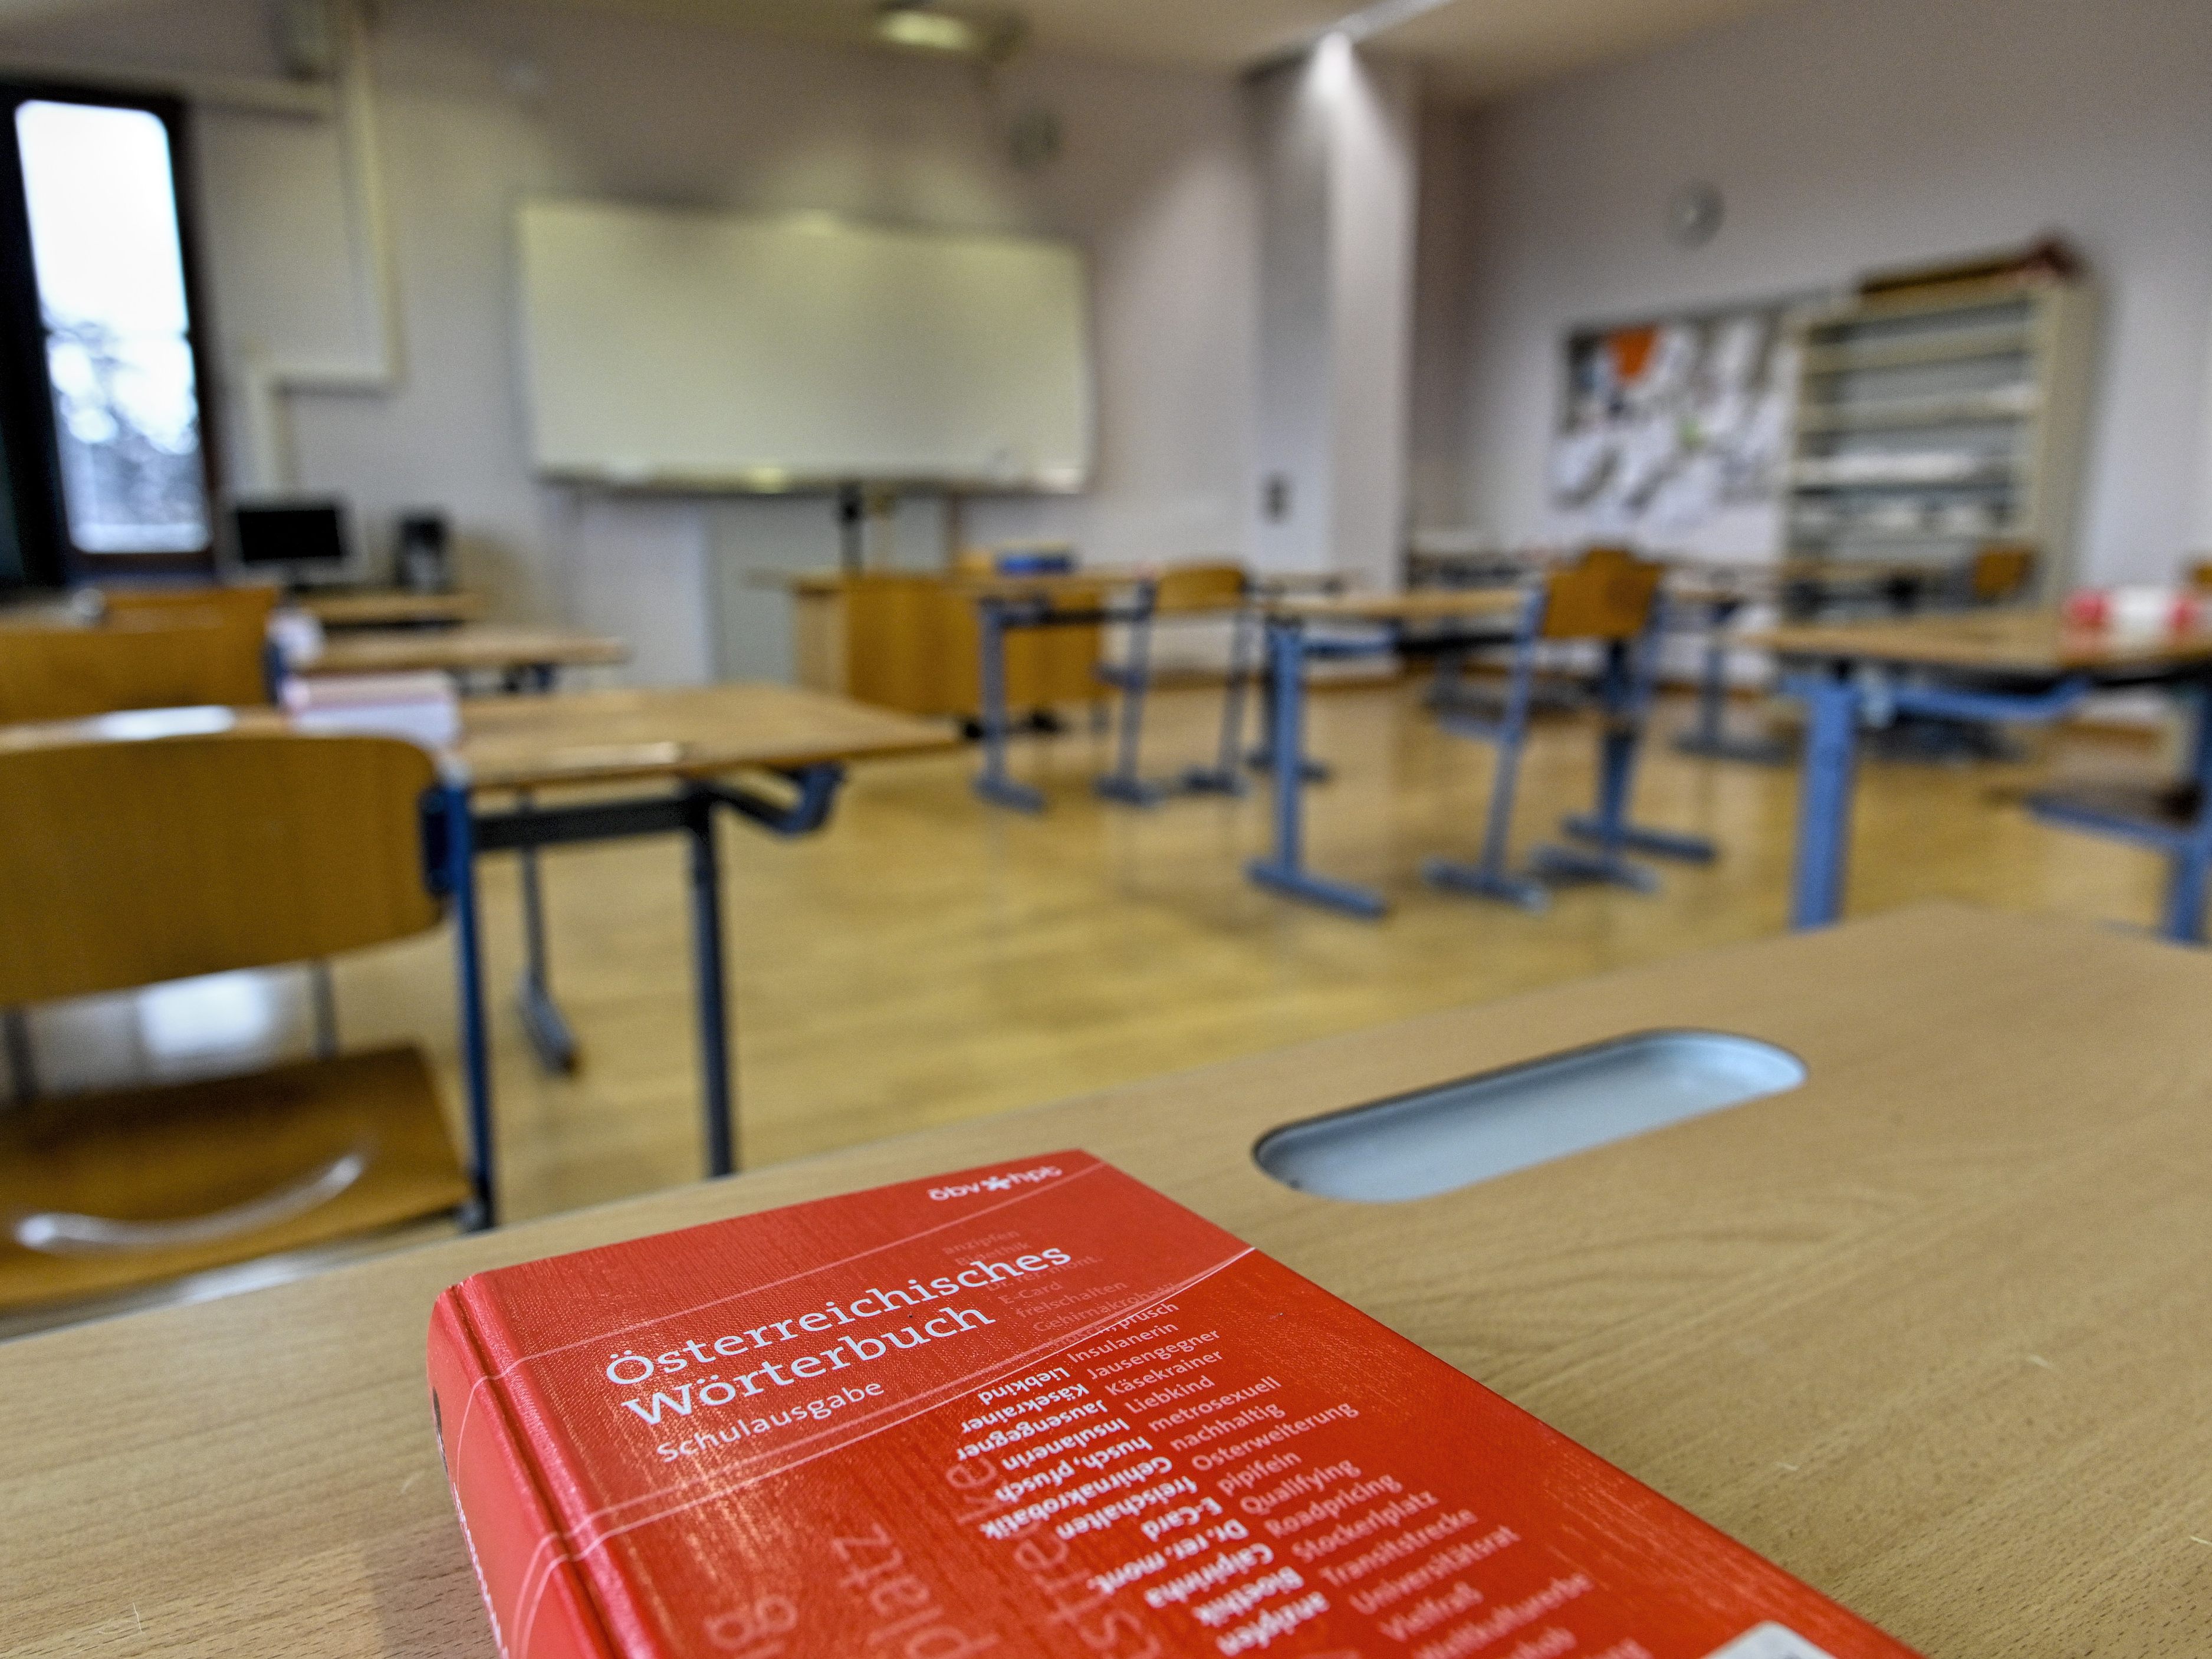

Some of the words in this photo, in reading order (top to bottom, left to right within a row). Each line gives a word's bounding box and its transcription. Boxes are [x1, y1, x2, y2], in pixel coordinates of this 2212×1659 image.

[606, 1247, 1071, 1385] Österreichisches
[1067, 1320, 1179, 1364] Insulanerin
[621, 1306, 995, 1426] Wörterbuch
[1086, 1329, 1221, 1380] Jausengegner
[1105, 1349, 1224, 1397] Käsekrainer
[961, 1382, 1090, 1434] Käsekrainer
[978, 1366, 1072, 1405] Liebkind
[1124, 1375, 1215, 1414] Liebkind
[1148, 1375, 1282, 1433] metrosexuell
[657, 1382, 885, 1462] Schulausgabe
[956, 1400, 1109, 1463] Jausengegner
[1002, 1418, 1130, 1471] Insulanerin
[1170, 1401, 1286, 1452] nachhaltig
[1191, 1401, 1359, 1471] Osterweiterung
[1073, 1435, 1153, 1471] husch,
[978, 1456, 1174, 1540] Gehirnakrobatik
[995, 1458, 1075, 1503] pfusch
[1240, 1458, 1362, 1515] Qualifying
[1264, 1473, 1403, 1538] Roadpricing
[1056, 1475, 1198, 1540] freischalten
[1140, 1496, 1223, 1542] E-Card
[1206, 1517, 1250, 1542] Dr.
[1086, 1550, 1167, 1594] mont.
